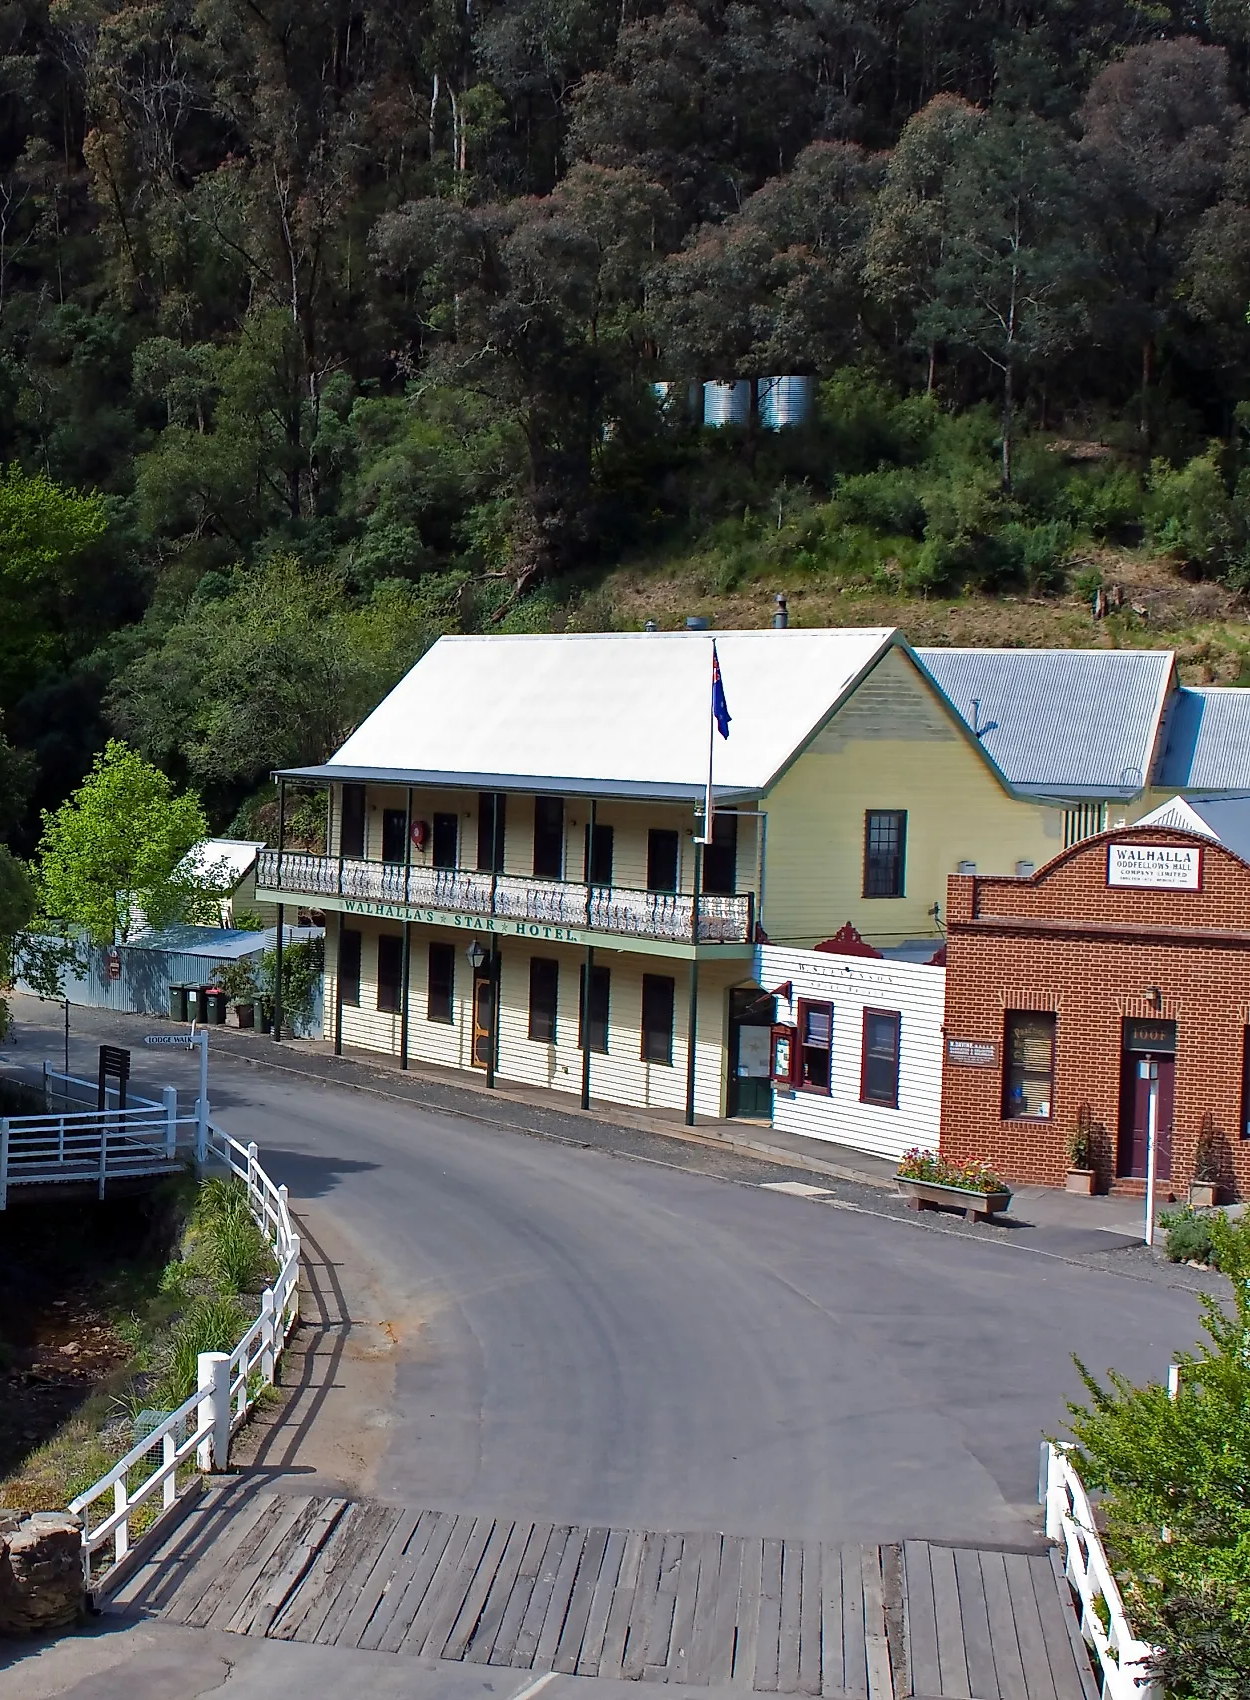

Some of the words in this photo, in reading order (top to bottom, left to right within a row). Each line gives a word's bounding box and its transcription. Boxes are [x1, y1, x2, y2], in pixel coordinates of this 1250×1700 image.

[1116, 849, 1192, 863] WALHALLA
[1116, 860, 1170, 871] ODDFELLOWS
[1172, 863, 1192, 871] HALL
[345, 900, 435, 922] WALHALLA'S
[454, 915, 495, 931] STAR
